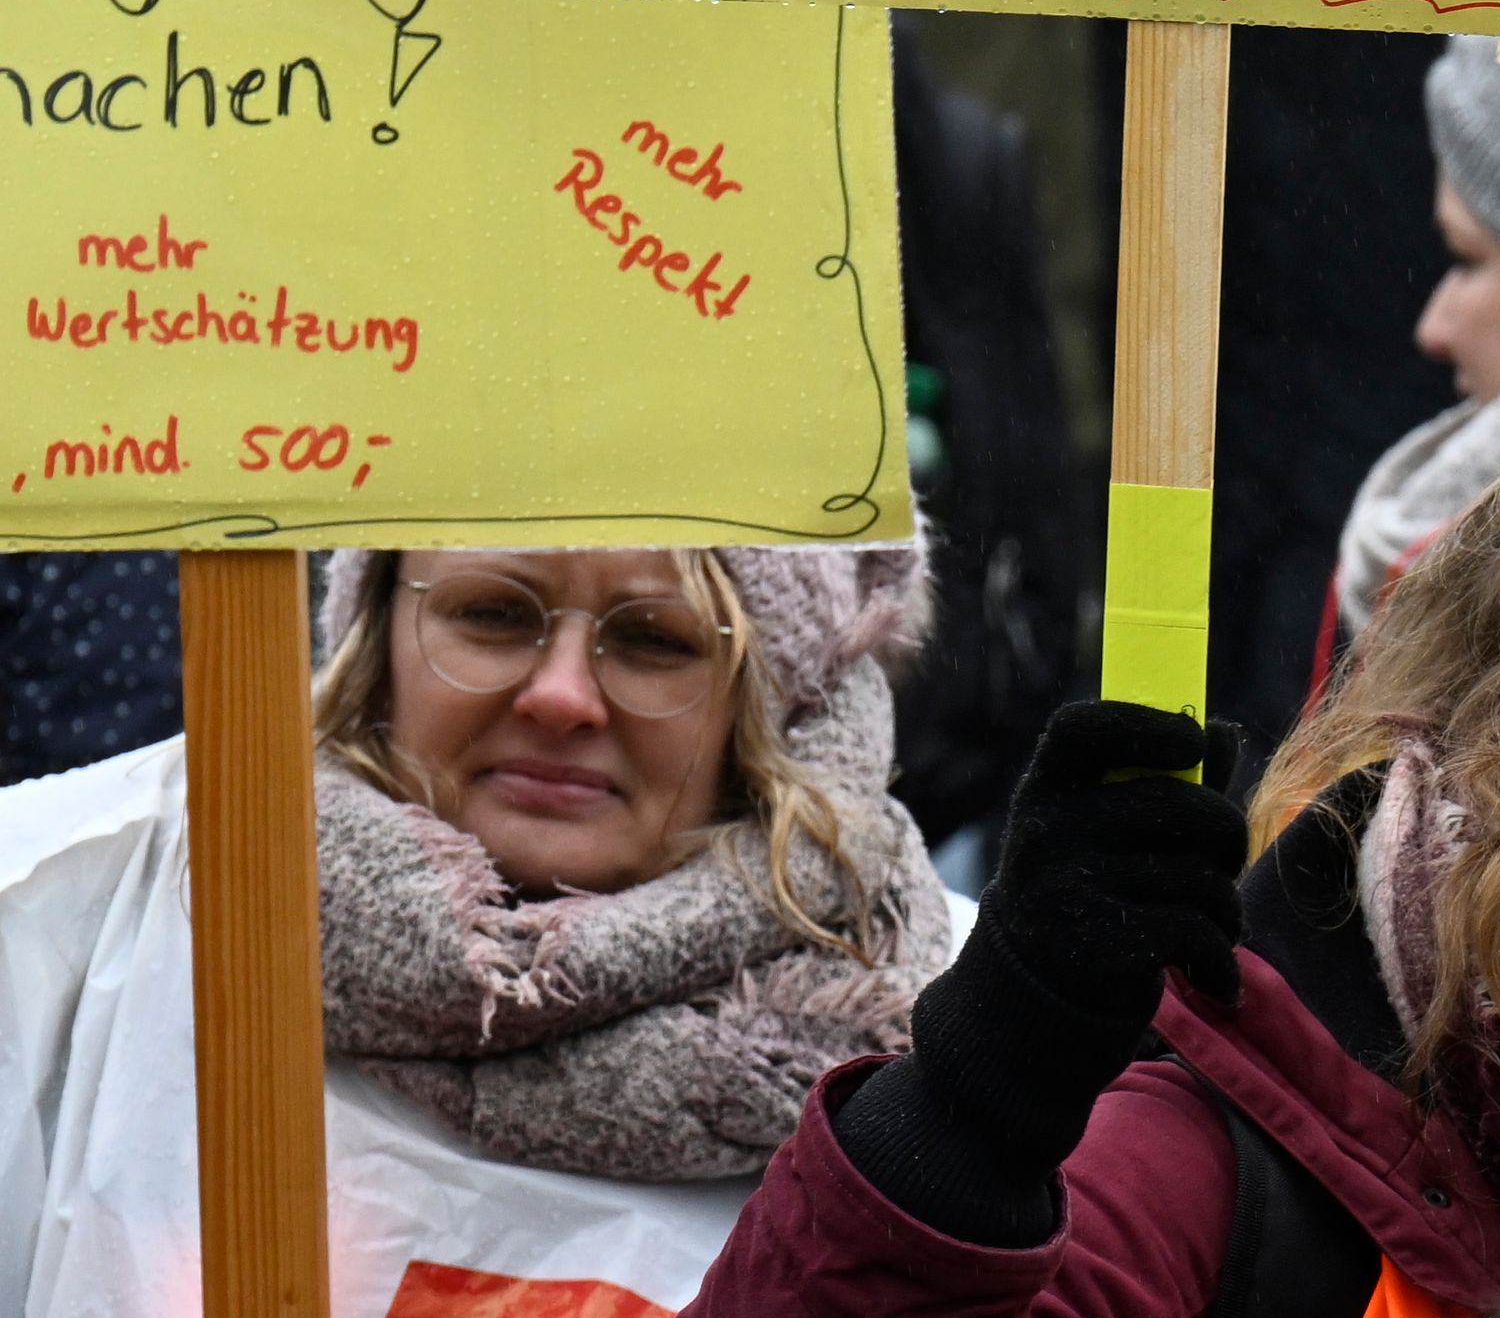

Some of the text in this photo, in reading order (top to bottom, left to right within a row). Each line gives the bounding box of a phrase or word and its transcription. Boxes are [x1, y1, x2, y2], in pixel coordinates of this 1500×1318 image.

[621, 120, 743, 201] mehr
[78, 213, 208, 273] mehr
[554, 147, 753, 323] Respekt
